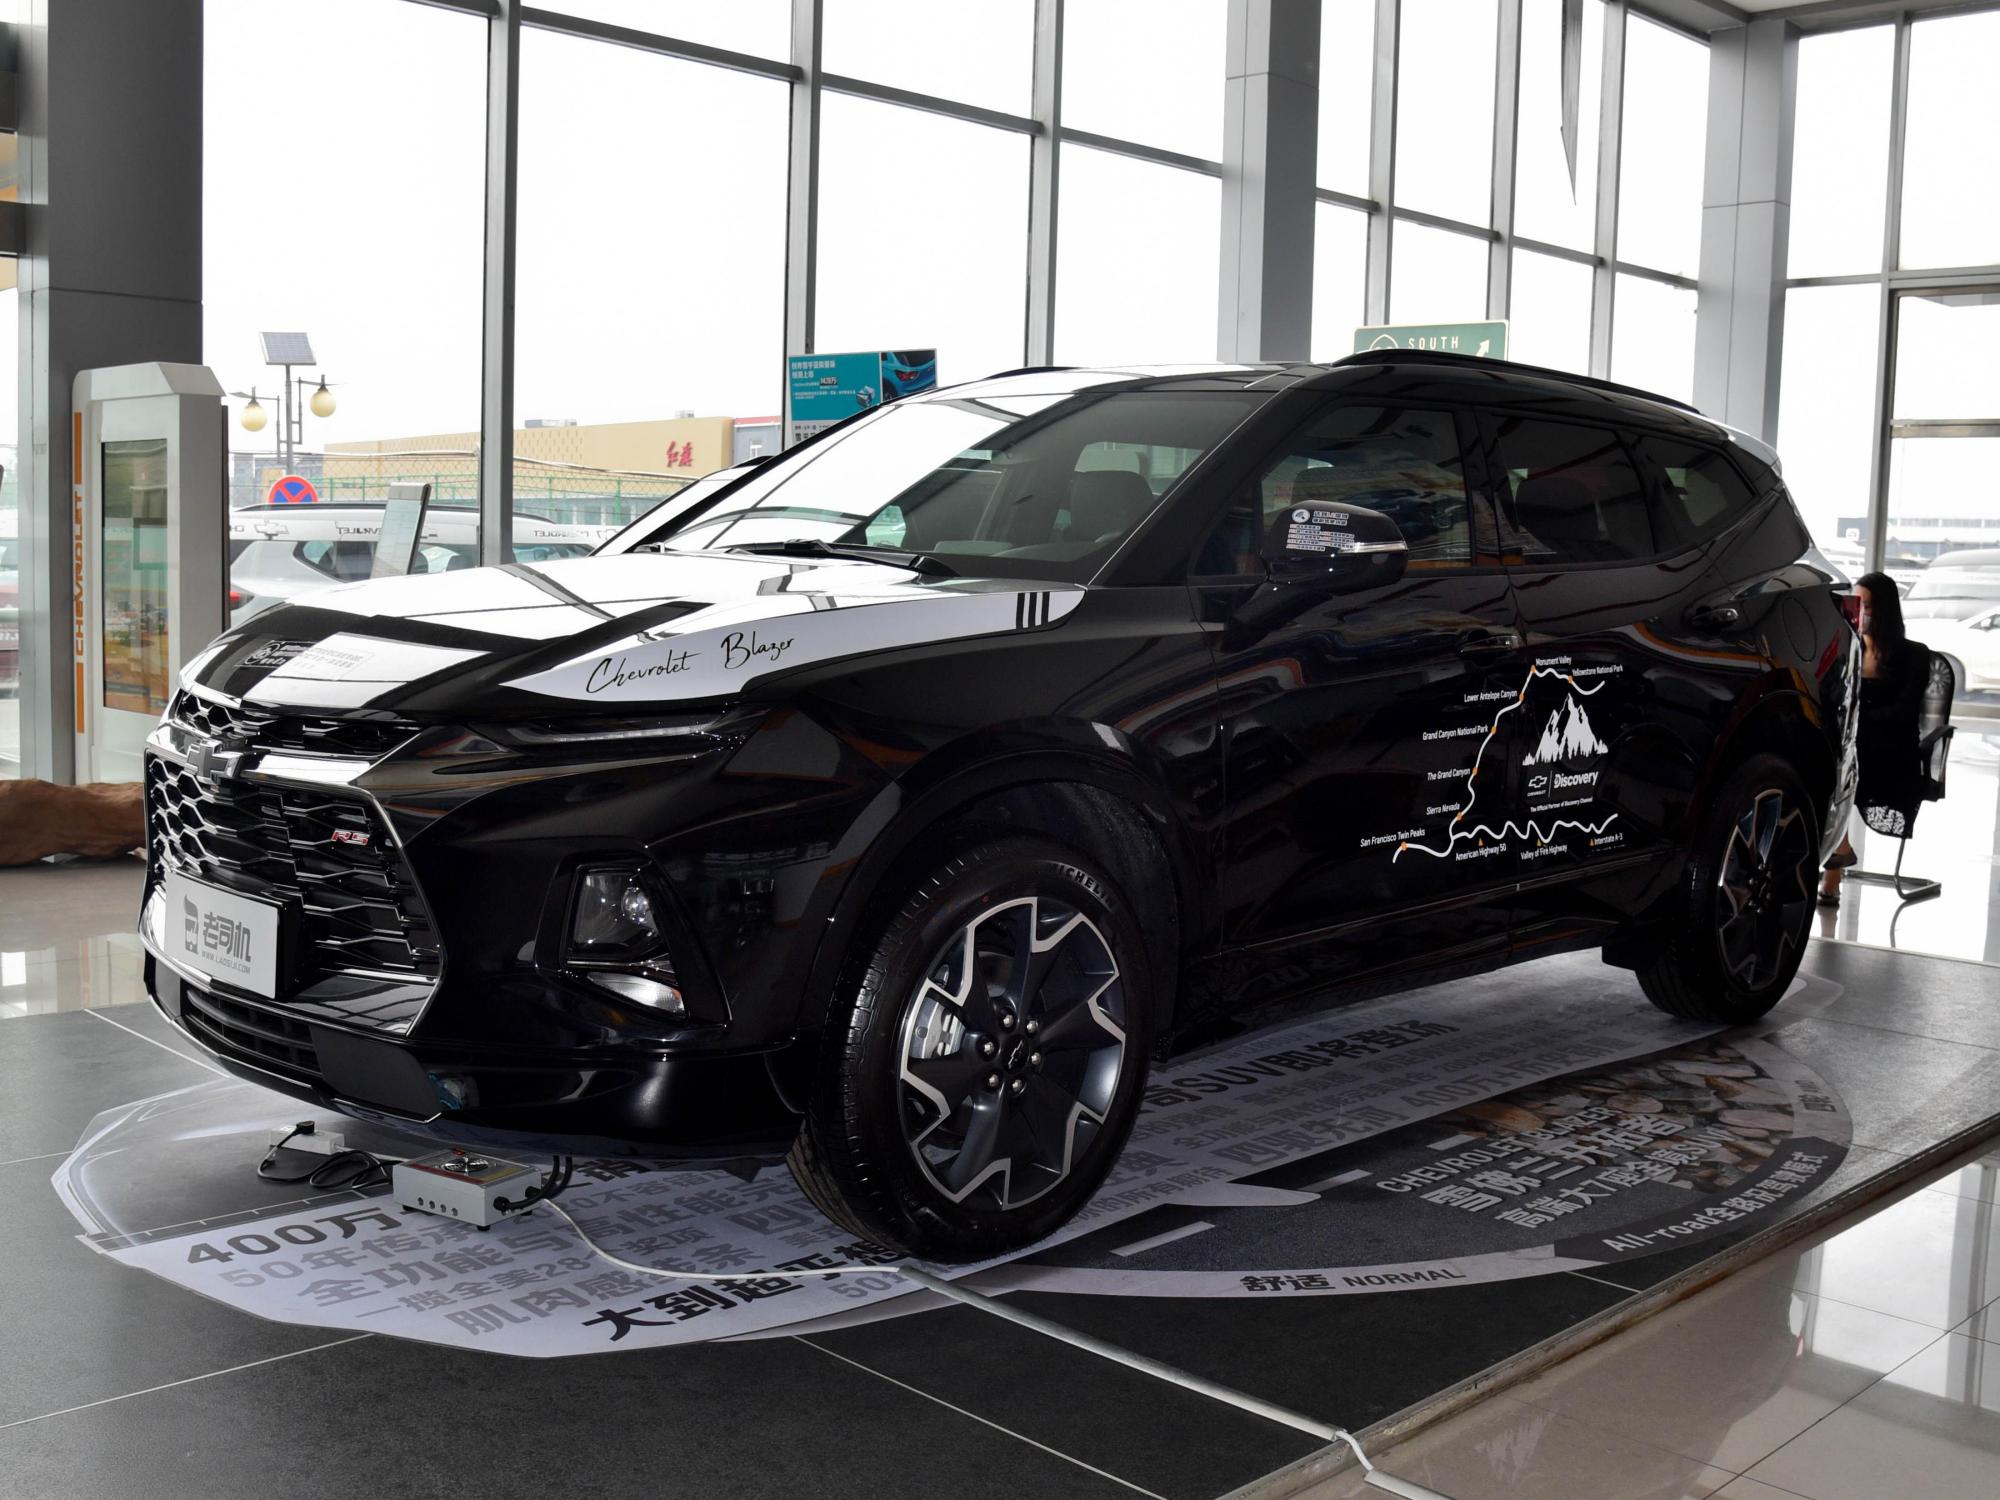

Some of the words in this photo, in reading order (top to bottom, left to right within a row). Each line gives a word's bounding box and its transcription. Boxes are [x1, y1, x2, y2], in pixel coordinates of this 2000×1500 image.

[1408, 336, 1459, 350] SOUTH
[74, 491, 84, 656] CHEVROLET
[585, 649, 701, 693] Chevrolet
[721, 631, 795, 669] Blazer
[1536, 657, 1559, 666] Monument
[1559, 655, 1572, 665] Valley
[1572, 668, 1596, 677] Yellowstone
[1597, 665, 1613, 674] National
[1613, 664, 1624, 673] Park
[1464, 693, 1479, 703] Lower
[1480, 690, 1500, 701] Antelope
[1500, 689, 1518, 699] Canyon
[1422, 730, 1438, 741] Grand
[1438, 729, 1457, 739] Canyon
[1457, 726, 1477, 736] National
[1477, 724, 1489, 733] Park
[1427, 772, 1436, 781] The
[1437, 770, 1452, 780] Grand
[1452, 768, 1471, 778] Canyon
[1554, 771, 1599, 789] Discovery
[1426, 806, 1441, 815] Sierra
[1442, 802, 1460, 812] Nevada
[331, 828, 370, 846] RS
[1360, 838, 1371, 848] San
[1371, 833, 1397, 845] Francisco
[1398, 830, 1409, 840] Twin
[1409, 828, 1425, 837] Peaks
[1455, 848, 1479, 861] American
[1479, 846, 1500, 858] Highway
[1499, 843, 1507, 852] 50
[1520, 850, 1534, 860] Valley
[203, 911, 251, 963] 老司机
[1376, 1136, 1530, 1192] CHEVROLET
[1526, 1107, 1617, 1142] BLAZER
[1419, 1114, 1687, 1212] 雪佛兰开拓者
[1240, 1273, 1336, 1292] 舒适
[1342, 1268, 1466, 1287] NORMAL
